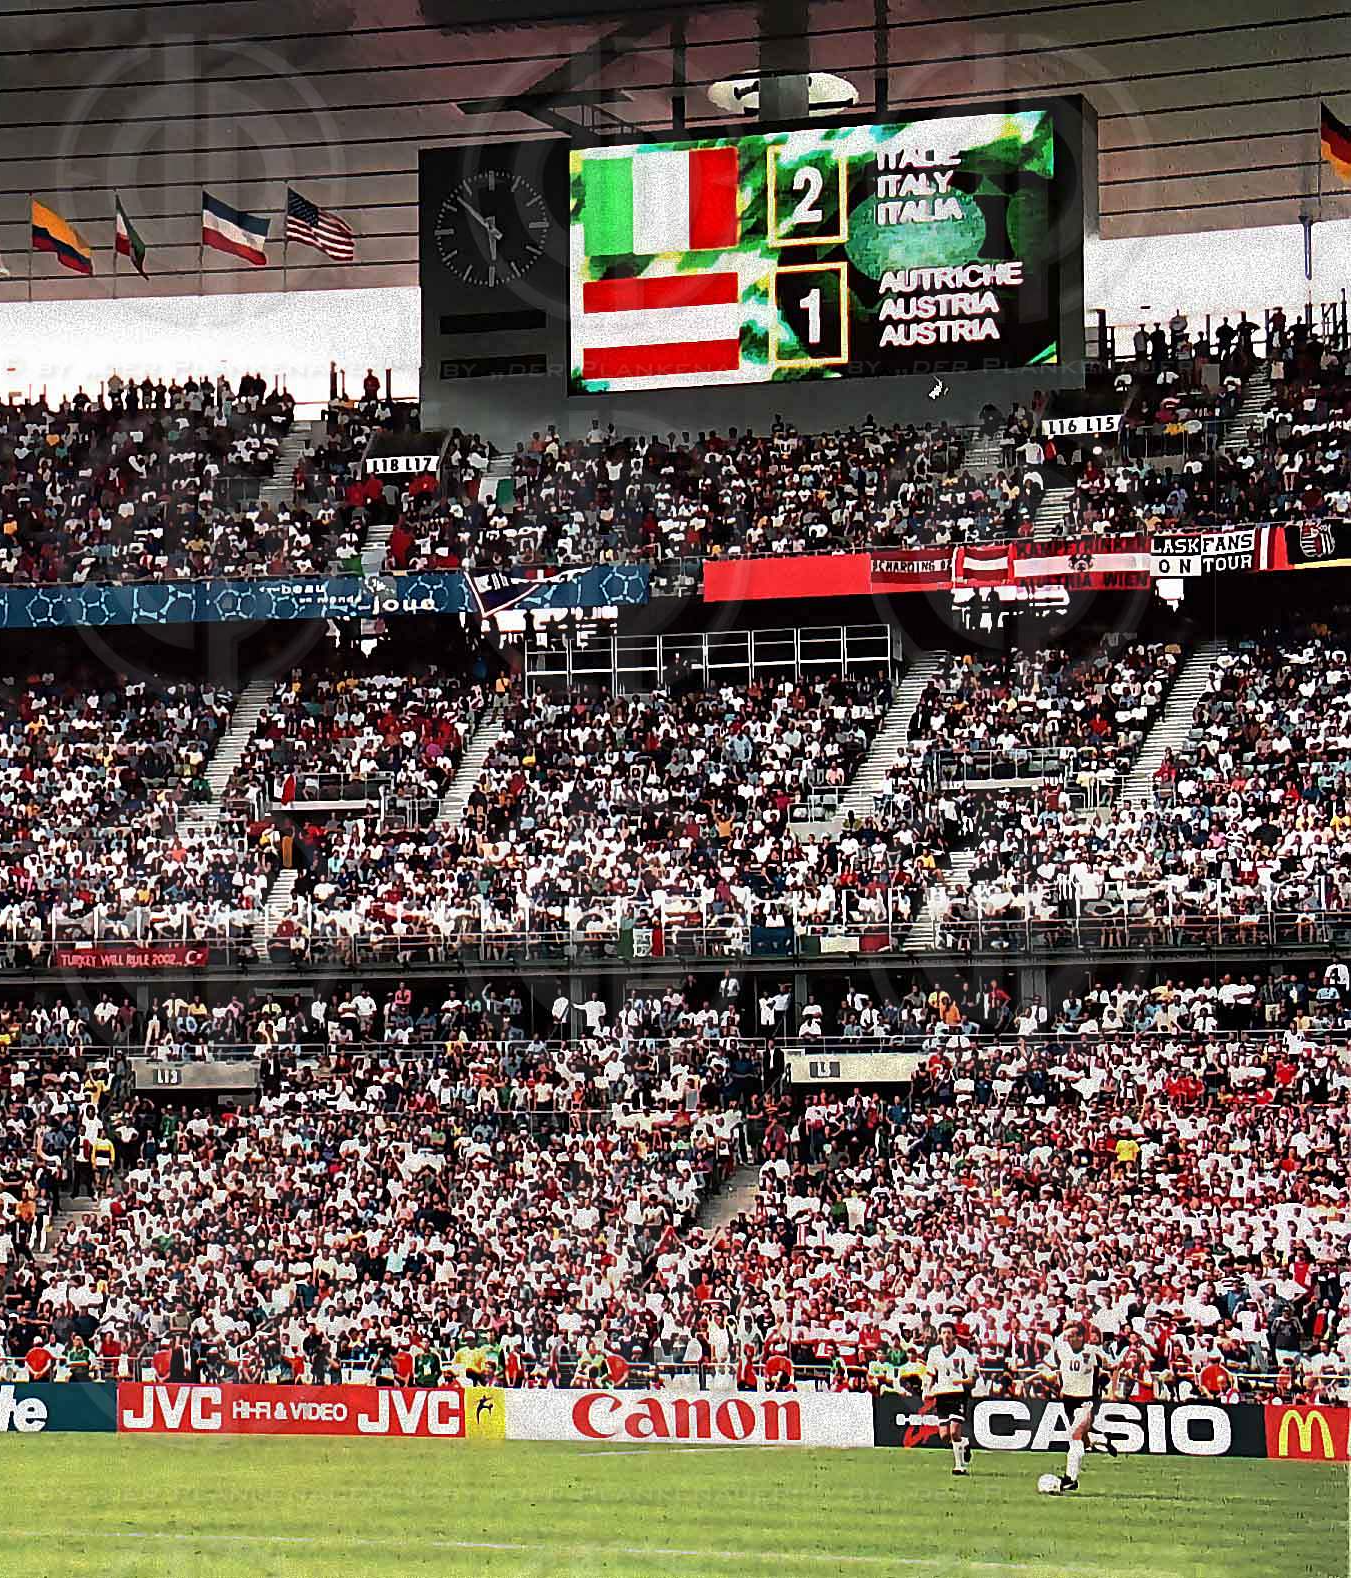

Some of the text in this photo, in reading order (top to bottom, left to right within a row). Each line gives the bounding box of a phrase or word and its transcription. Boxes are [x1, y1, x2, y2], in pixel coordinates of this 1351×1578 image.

[793, 166, 824, 224] 2
[877, 170, 954, 198] ITALY
[877, 197, 964, 225] ITALIA
[879, 262, 1024, 294] AUTRICHE
[799, 288, 820, 344] 1
[879, 290, 1000, 321] AUSTRIA
[879, 317, 1001, 348] AUSTRIA
[1049, 416, 1115, 435] L16 L15
[372, 457, 432, 473] L18 L17
[1151, 534, 1253, 555] LASK FANS
[1203, 554, 1252, 574] TOUR
[60, 954, 96, 968] TURKEY
[100, 953, 124, 966] WILL
[1069, 1359, 1081, 1372] 10
[123, 1386, 223, 1430] JVC
[274, 1403, 288, 1421] &
[289, 1403, 348, 1424] VIDEO
[357, 1389, 461, 1436] JVC
[571, 1392, 803, 1441] Canon
[972, 1400, 1233, 1456] CASIO
